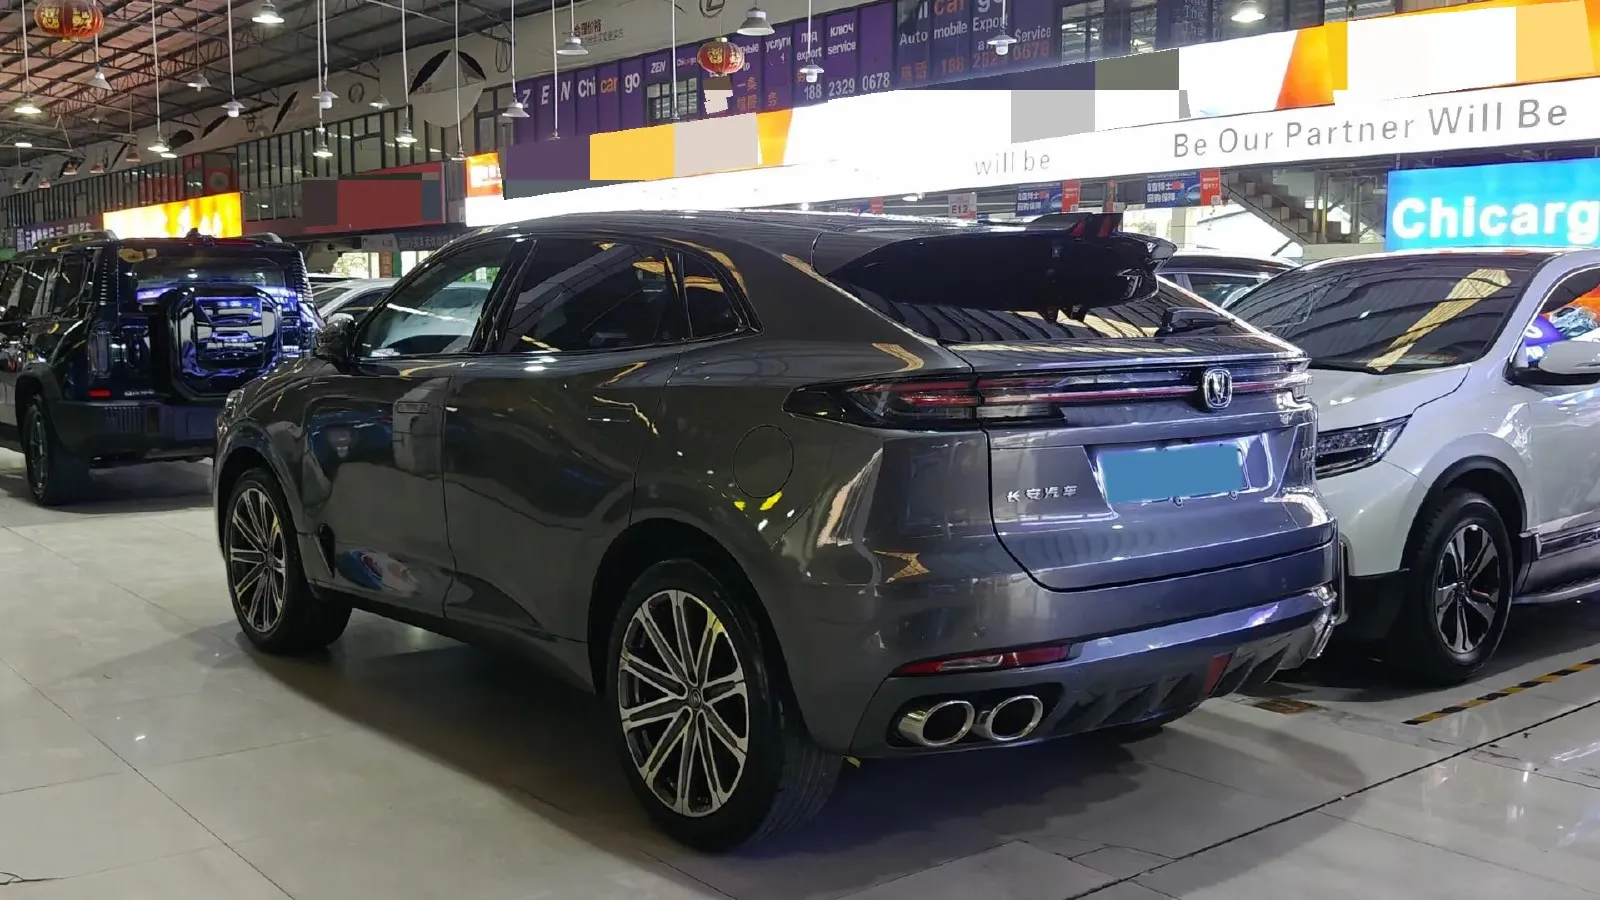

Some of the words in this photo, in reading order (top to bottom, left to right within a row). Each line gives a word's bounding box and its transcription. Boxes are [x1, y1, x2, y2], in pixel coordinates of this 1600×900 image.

[829, 22, 854, 38] ключ
[899, 30, 928, 47] Auto
[933, 21, 968, 40] mobile
[1014, 25, 1052, 44] Service
[796, 46, 823, 62] export
[827, 40, 857, 56] service
[650, 60, 666, 75] ZEN
[577, 76, 596, 98] Chi
[600, 75, 618, 94] car
[624, 71, 641, 94] go
[804, 84, 822, 102] 188
[828, 77, 856, 97] 2329
[862, 71, 891, 92] 0678
[1173, 132, 1206, 159] Be
[1218, 127, 1275, 154] Our
[1286, 116, 1415, 148] Partner
[1428, 101, 1503, 137] Will
[1517, 98, 1569, 130] Be
[974, 151, 1016, 177] will
[1024, 150, 1052, 174] be
[951, 204, 969, 214] E12
[1007, 484, 1078, 503] 长安汽车
